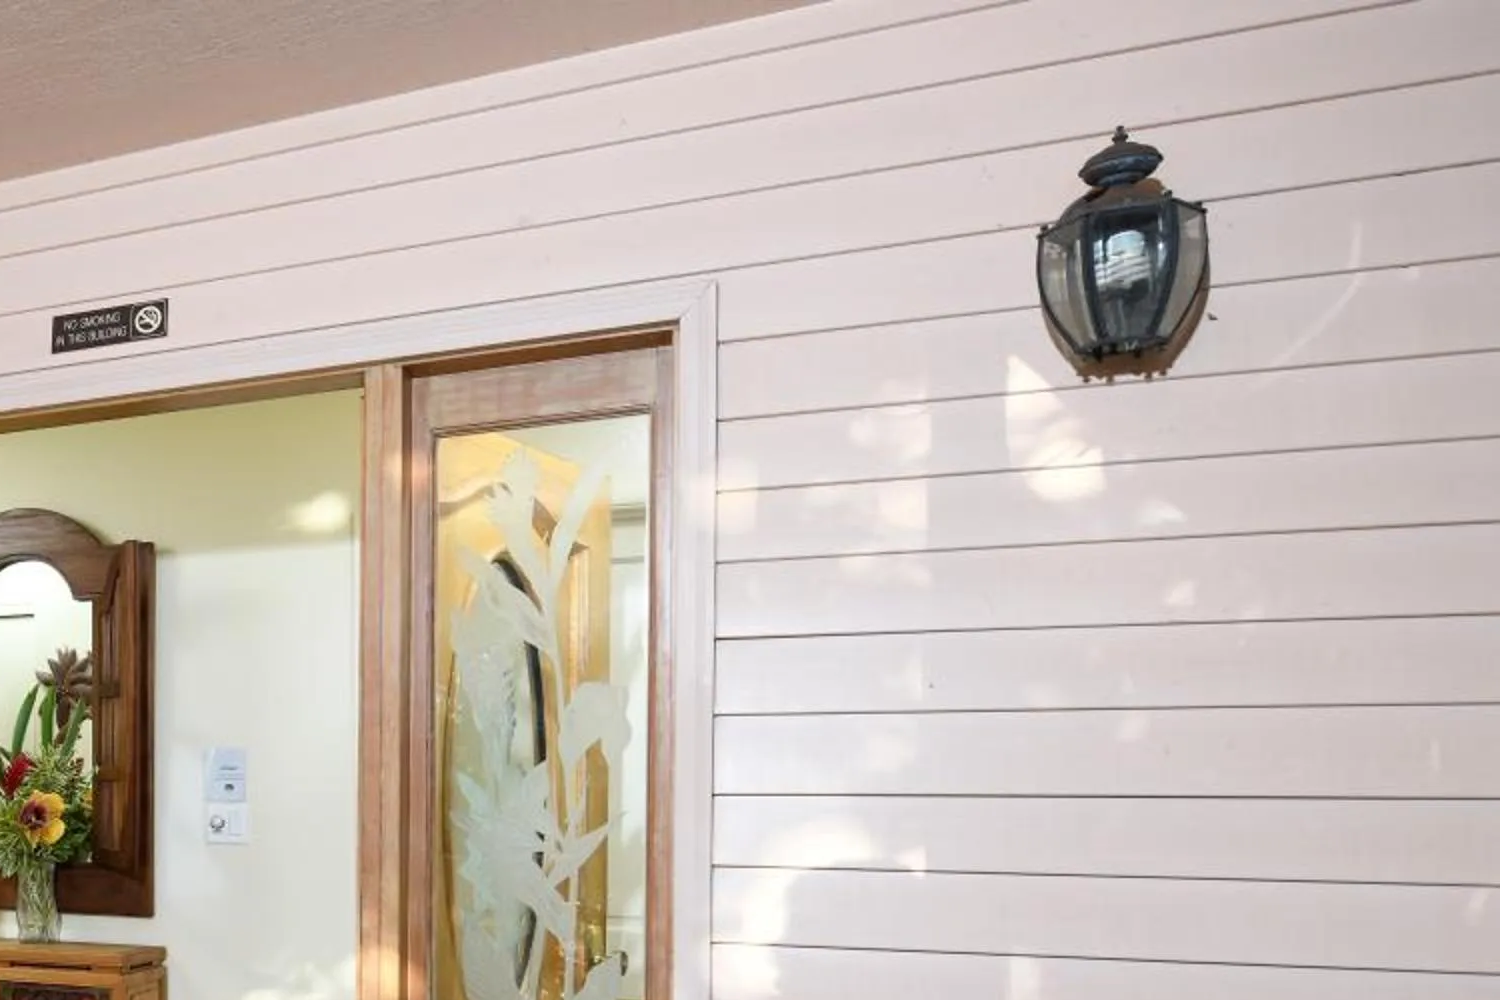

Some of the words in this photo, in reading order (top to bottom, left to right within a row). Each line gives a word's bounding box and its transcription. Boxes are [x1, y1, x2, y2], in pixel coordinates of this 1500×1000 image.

[64, 319, 78, 331] NO
[80, 311, 121, 328] SMOKING
[55, 335, 65, 347] IN
[68, 332, 86, 344] THIS
[87, 326, 127, 342] BUILDING
